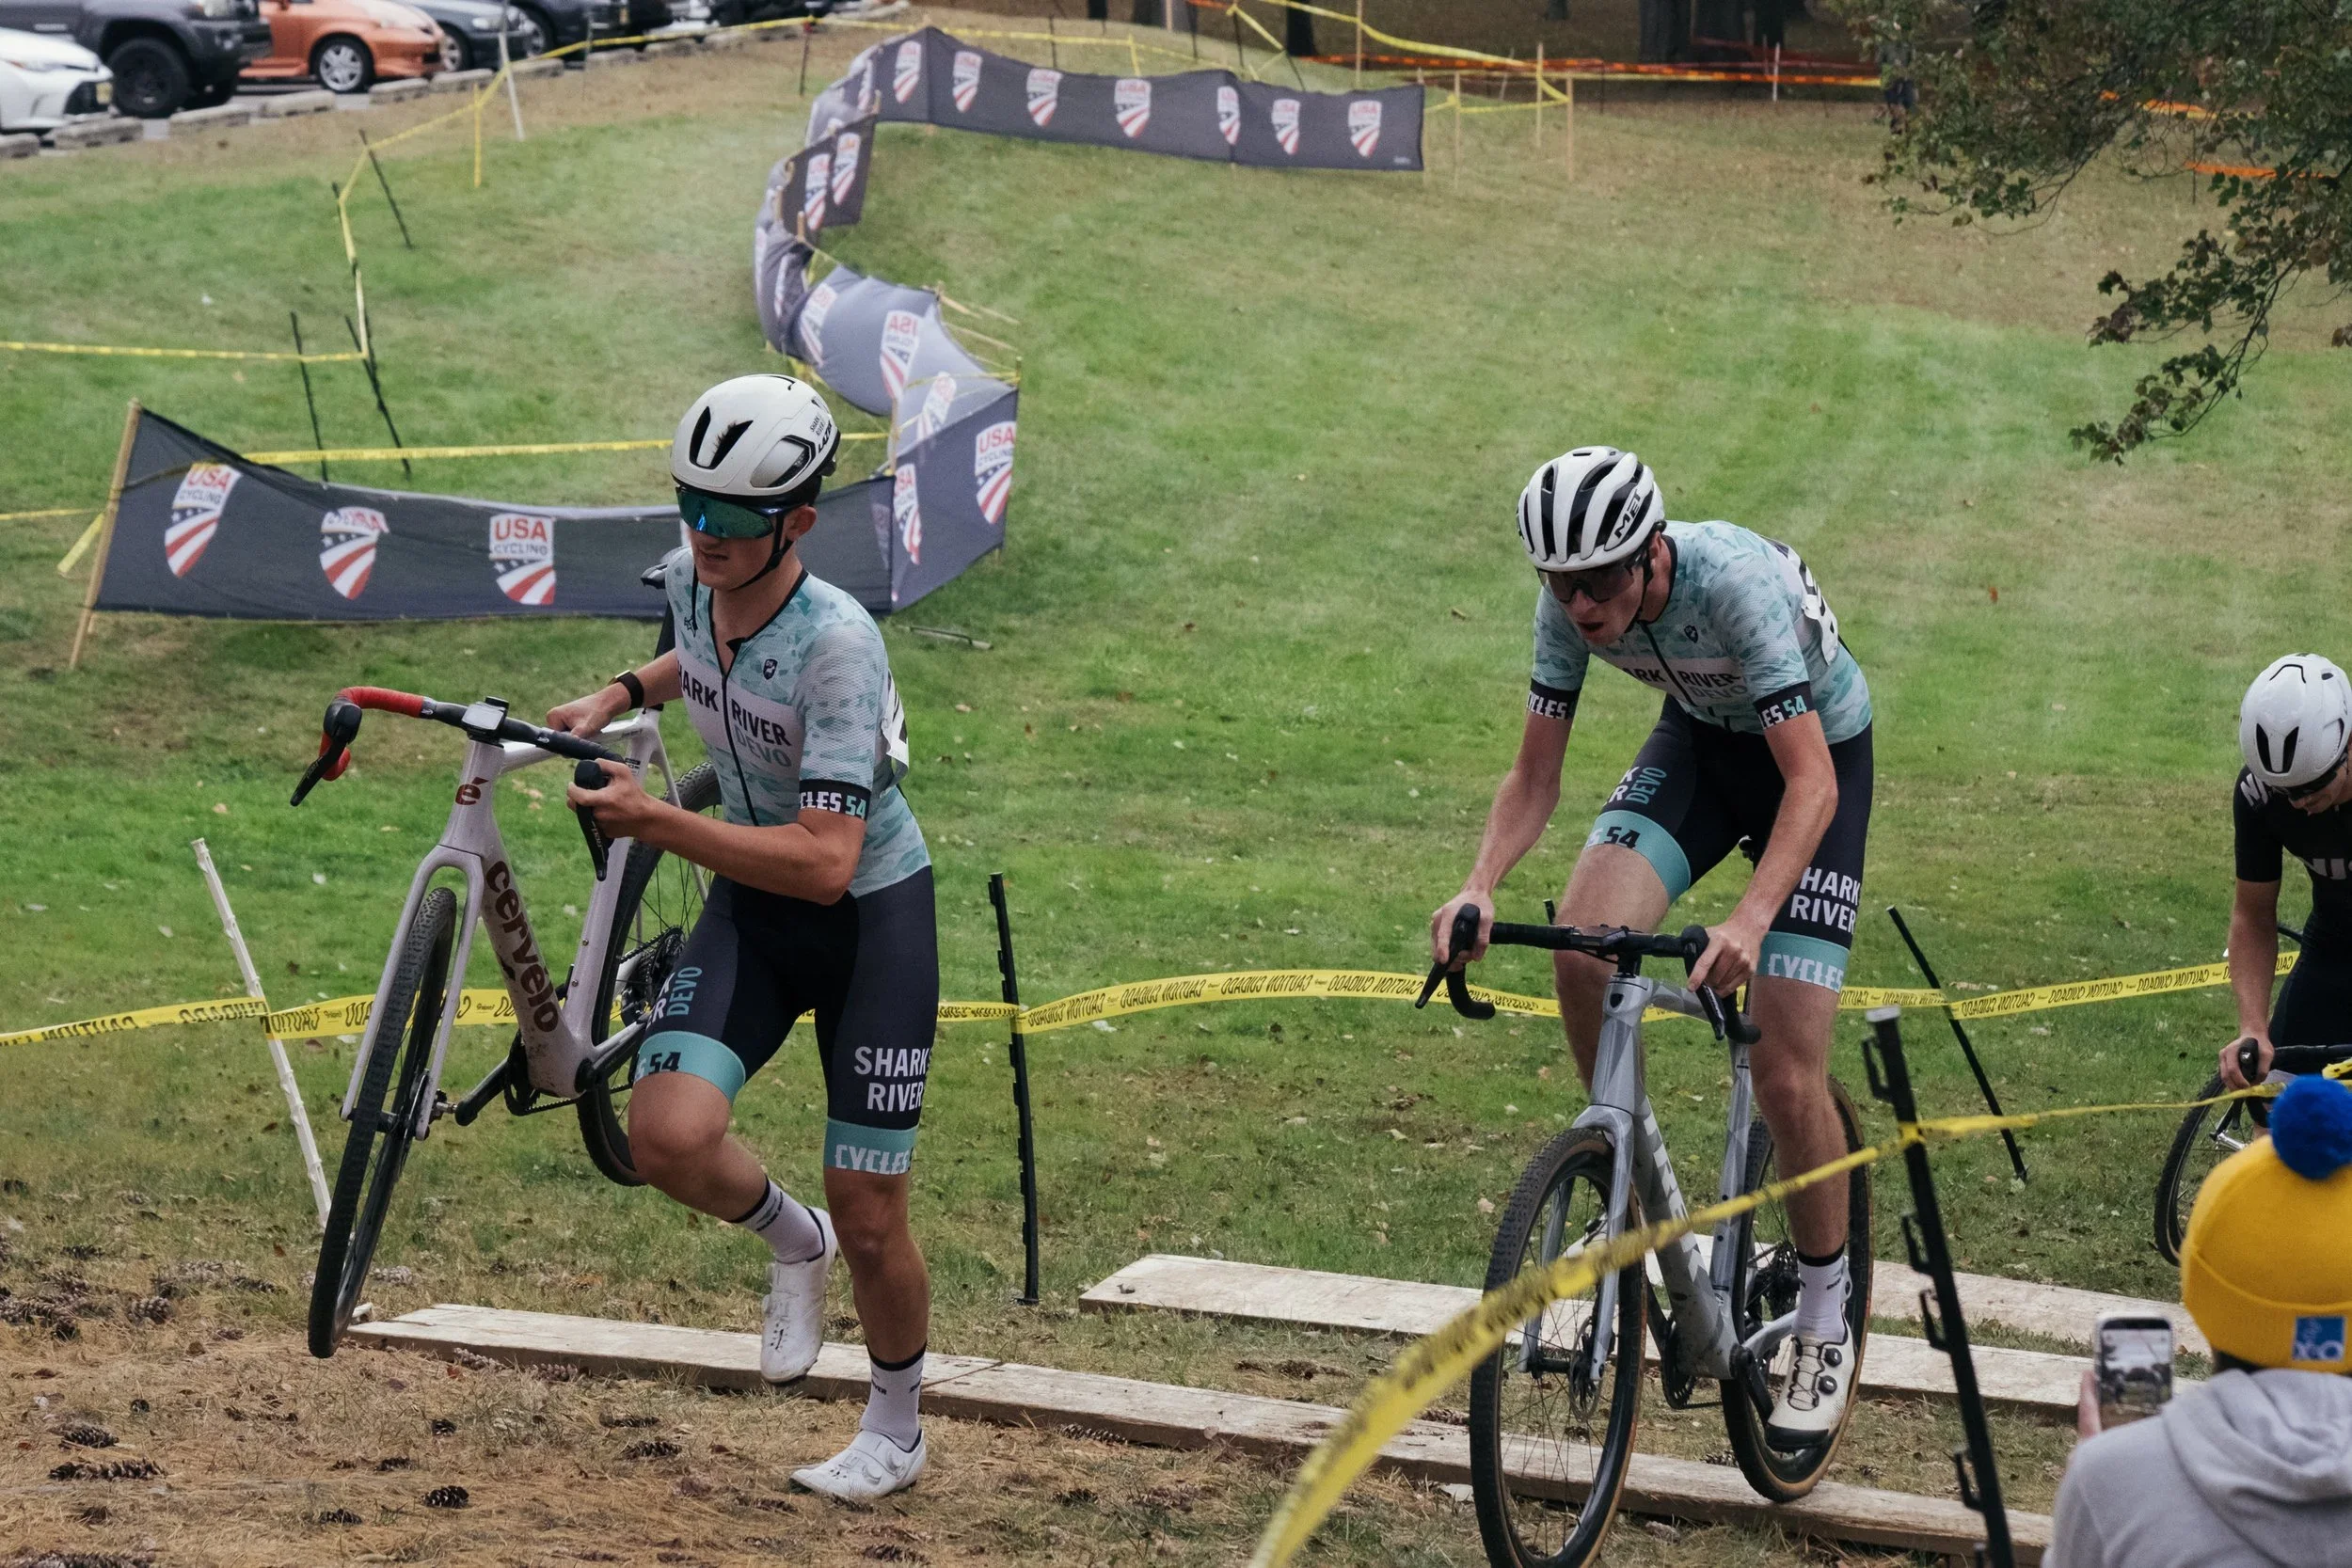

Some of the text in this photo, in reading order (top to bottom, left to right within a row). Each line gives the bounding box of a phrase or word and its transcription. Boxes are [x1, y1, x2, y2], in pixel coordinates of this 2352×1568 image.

[978, 426, 1014, 453] USA
[188, 465, 232, 493] USA
[178, 488, 222, 505] CYCLING
[1614, 489, 1641, 539] MET
[495, 518, 548, 543] USA
[493, 543, 548, 556] CYCLING
[1623, 667, 1741, 689] ARK RIVER
[677, 660, 792, 747] HARK RIVER
[1782, 694, 1807, 719] 54
[735, 724, 792, 768] DEVO
[1625, 767, 1667, 805] DEVO
[800, 791, 867, 820] CLES 54
[1604, 826, 1641, 848] 54
[1799, 866, 1861, 906] HARK
[1789, 894, 1857, 934] RIVER
[1768, 952, 1844, 994] CYCLES
[665, 966, 703, 1017] DEVO
[648, 1051, 681, 1075] 54
[853, 1046, 930, 1077] SHARK
[866, 1082, 924, 1113] RIVER
[834, 1144, 912, 1176] CYCLES
